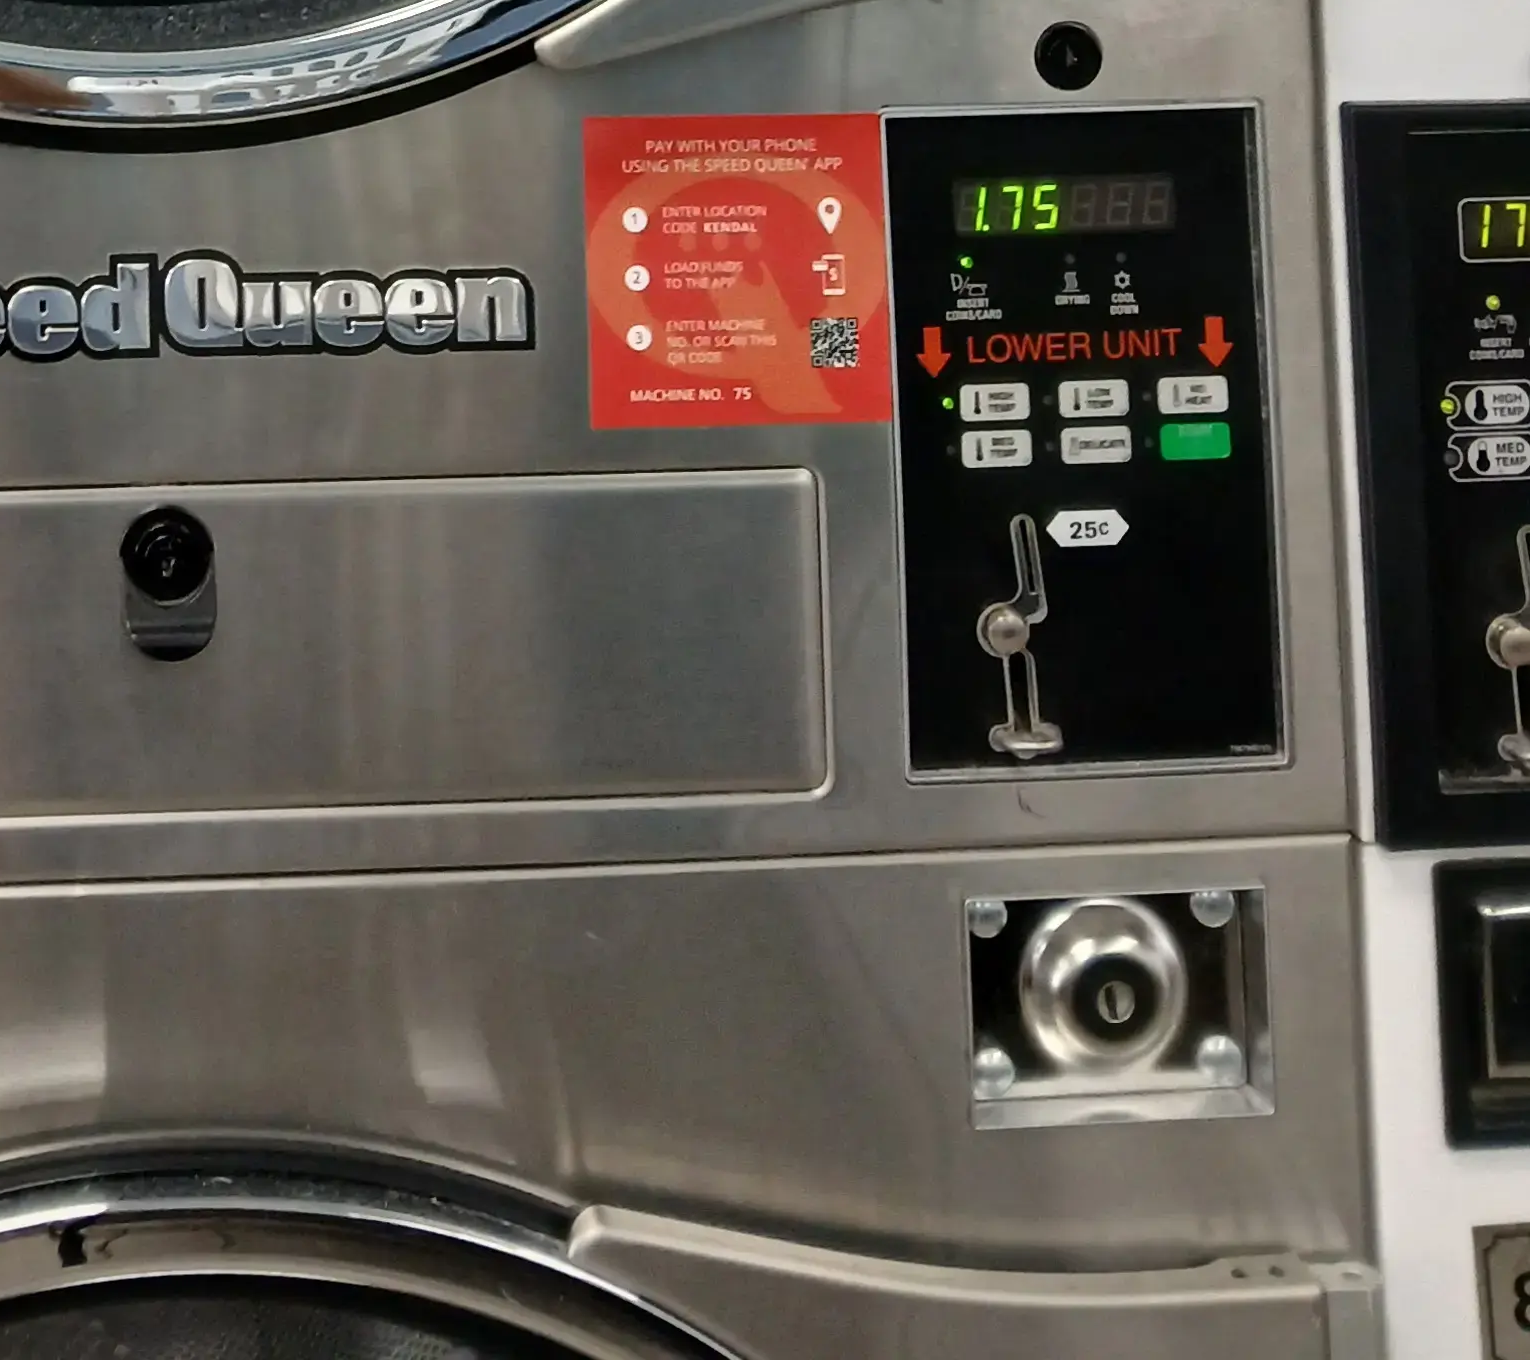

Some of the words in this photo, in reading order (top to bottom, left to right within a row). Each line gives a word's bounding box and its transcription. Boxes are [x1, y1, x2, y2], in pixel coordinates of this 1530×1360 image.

[645, 140, 673, 153] PAY
[676, 139, 715, 152] WITH
[719, 139, 761, 152] YOUR
[765, 138, 817, 151] PHONE
[622, 160, 669, 173] USING
[673, 159, 699, 172] THE
[704, 158, 751, 172] SPEED
[813, 157, 843, 170] APP
[662, 206, 701, 218] ENTER
[704, 205, 767, 217] LOCATION
[975, 184, 1060, 232] 1.75
[631, 213, 638, 225] 1
[663, 222, 697, 234] CODE
[703, 221, 757, 233] KENDAL
[633, 271, 641, 284] 2
[966, 331, 1091, 364] LOWER
[1103, 327, 1183, 359] UNIT
[630, 389, 696, 402] MACHINE
[733, 387, 752, 400] 75
[1492, 393, 1522, 404] HIGH
[1492, 406, 1524, 417] TEMP
[1496, 442, 1525, 453] MED
[1495, 455, 1528, 467] TEMP
